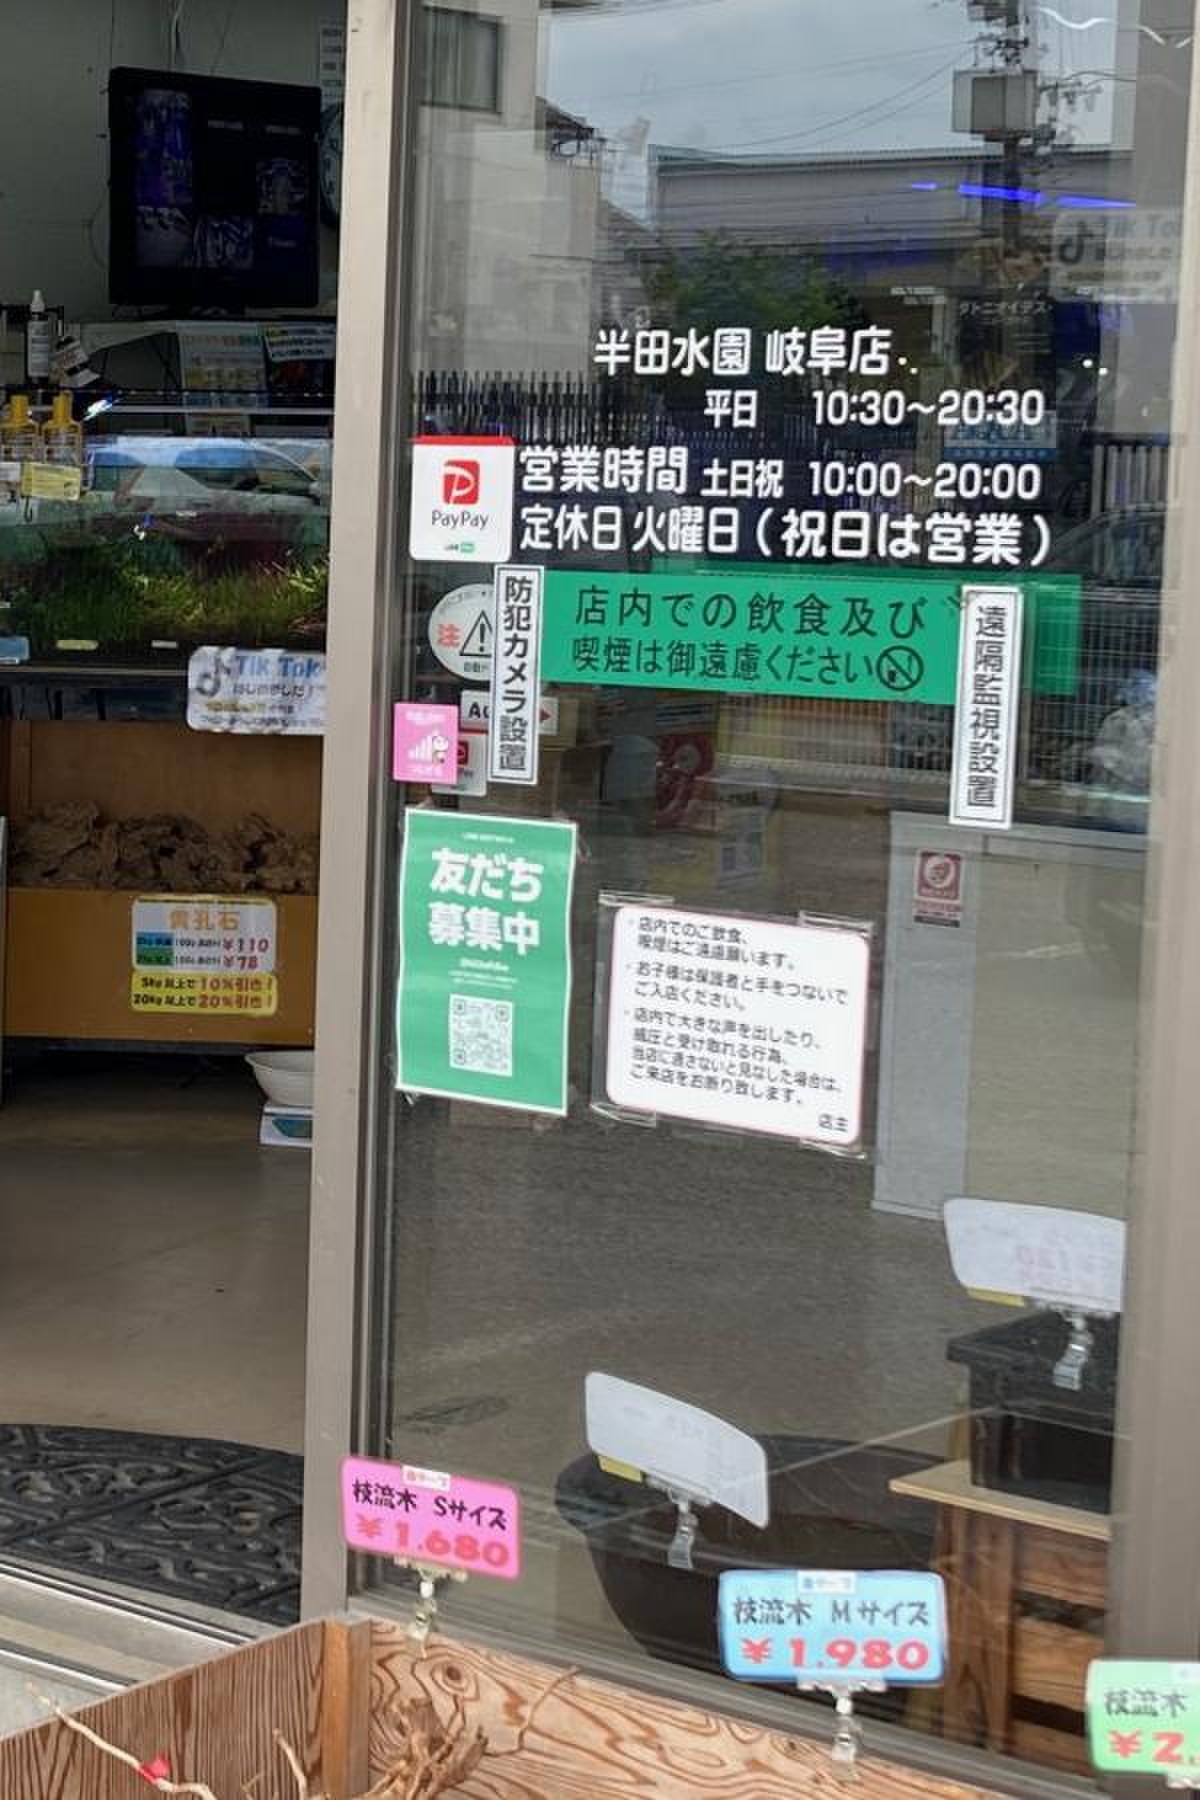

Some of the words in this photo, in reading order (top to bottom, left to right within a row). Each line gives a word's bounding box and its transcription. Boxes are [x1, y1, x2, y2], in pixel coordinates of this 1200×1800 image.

[594, 327, 750, 376] 半田水園
[765, 326, 892, 376] 岐阜店
[703, 389, 757, 429] 平日
[518, 445, 689, 496] 営業時間
[701, 460, 784, 499] 土日祝
[432, 510, 489, 529] PayPay
[519, 508, 621, 553] 定休日
[632, 510, 739, 555] 火曜日
[575, 588, 927, 639] 店内での飲食及び
[500, 575, 533, 771] 防犯カメラ設置
[572, 638, 875, 686] 喫煙は御遠慮ください
[967, 605, 1007, 809] 遠隔監視設置
[429, 847, 545, 903] 友だち
[428, 901, 541, 956] 募集中
[817, 1112, 850, 1133] 店主
[351, 1479, 417, 1513] 枝流木
[433, 1494, 507, 1531] Sサイズ
[733, 1596, 813, 1627] 枝流木
[1103, 1686, 1189, 1719] 枝流木
